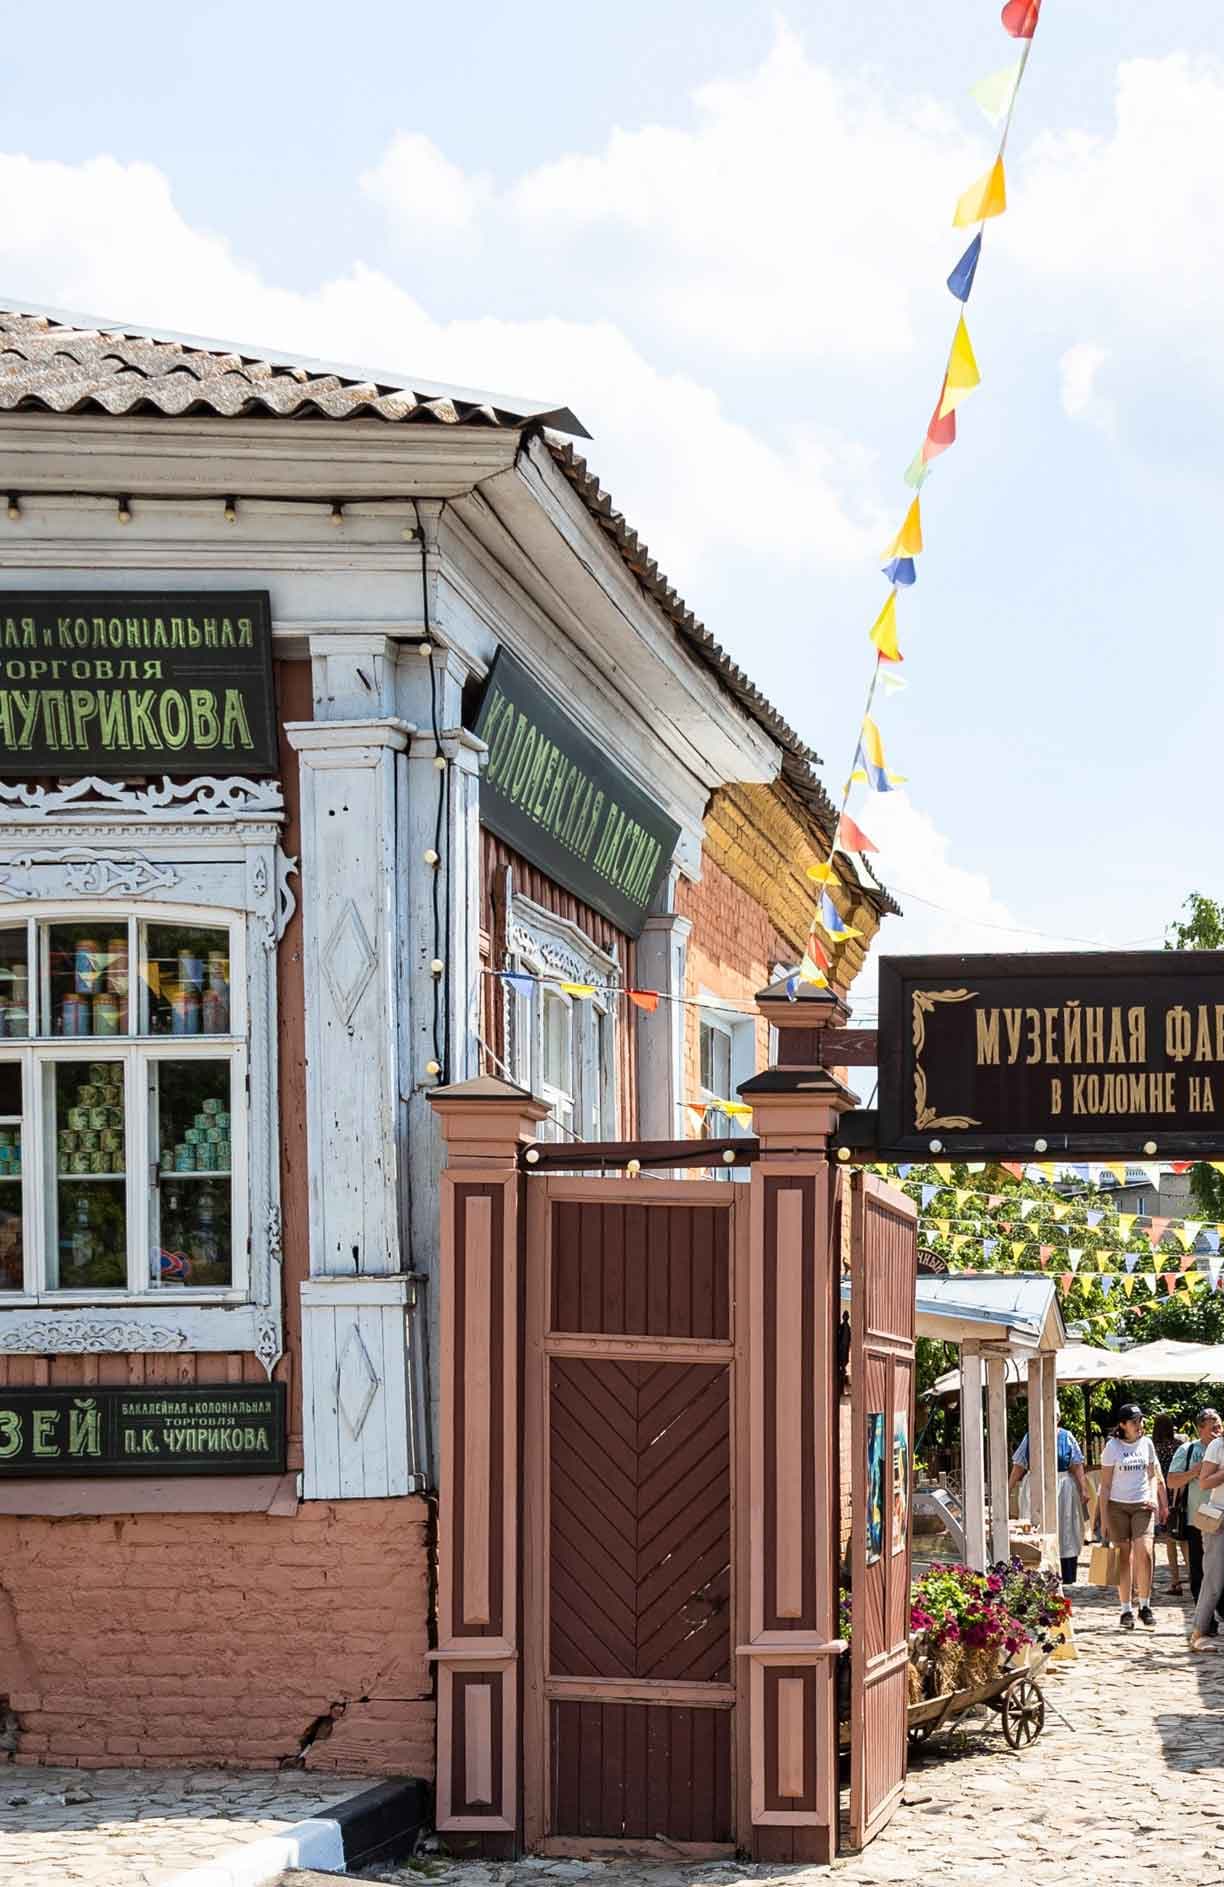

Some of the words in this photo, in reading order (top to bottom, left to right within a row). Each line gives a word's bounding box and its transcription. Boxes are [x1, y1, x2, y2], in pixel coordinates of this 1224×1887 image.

[0, 617, 37, 648] АЯ
[58, 617, 254, 648] КОЛОНІАЛЬНАЯ
[0, 659, 164, 680] ОРГОВЛЯ
[481, 690, 604, 862] КОЛОМЕНСКАЯ
[592, 802, 662, 910] ПАСТИЛА
[975, 1000, 1147, 1065] МУЗЕЙНАЯ
[1072, 1073, 1176, 1114] КОЛОМНЕ
[122, 1400, 187, 1416] БАКАЛЕЙНАЯ
[194, 1401, 272, 1415] КОЛОНІАЛЬНАЯ
[164, 1417, 236, 1426] ТОРГОВЛЯ
[124, 1429, 160, 1453] П.К.
[163, 1427, 269, 1452] ЧУПРИКОВА
